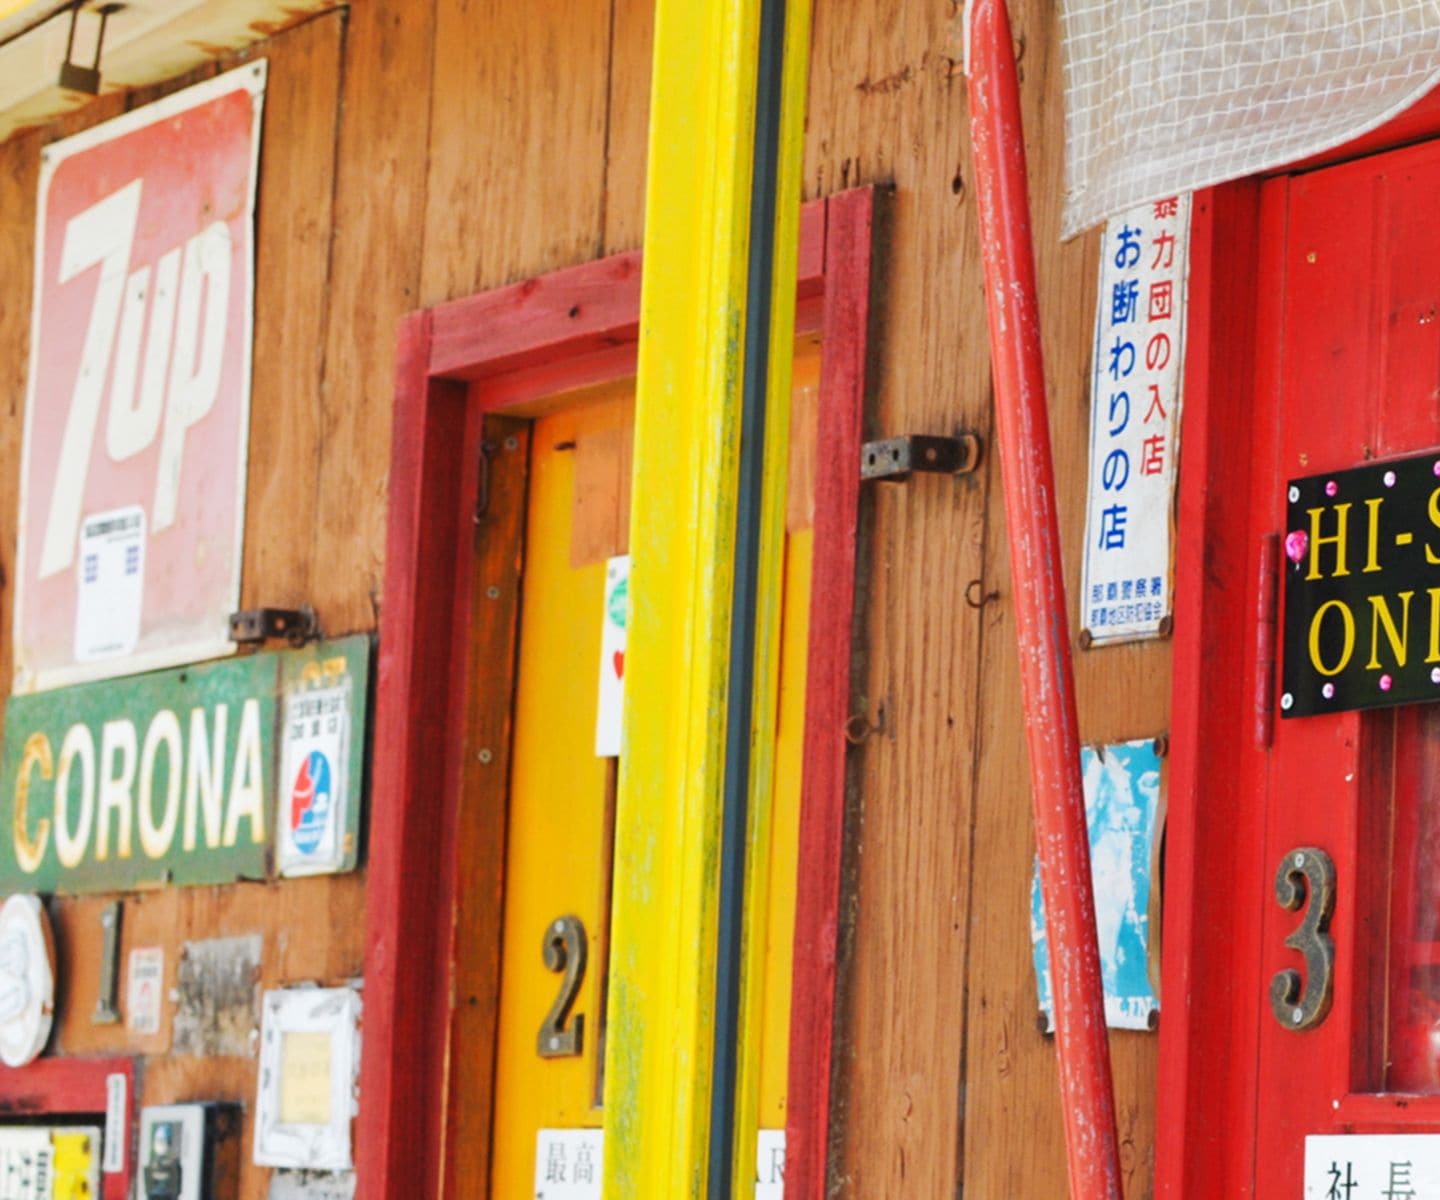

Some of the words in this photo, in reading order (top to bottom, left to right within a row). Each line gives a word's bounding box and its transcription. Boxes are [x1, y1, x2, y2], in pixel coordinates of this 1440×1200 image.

[40, 179, 232, 579] 7up
[1099, 224, 1142, 552] お断わりの店
[13, 698, 265, 873] CORONA
[537, 914, 589, 1058] 2
[1269, 846, 1336, 1031] 3
[546, 1141, 594, 1185] 最高
